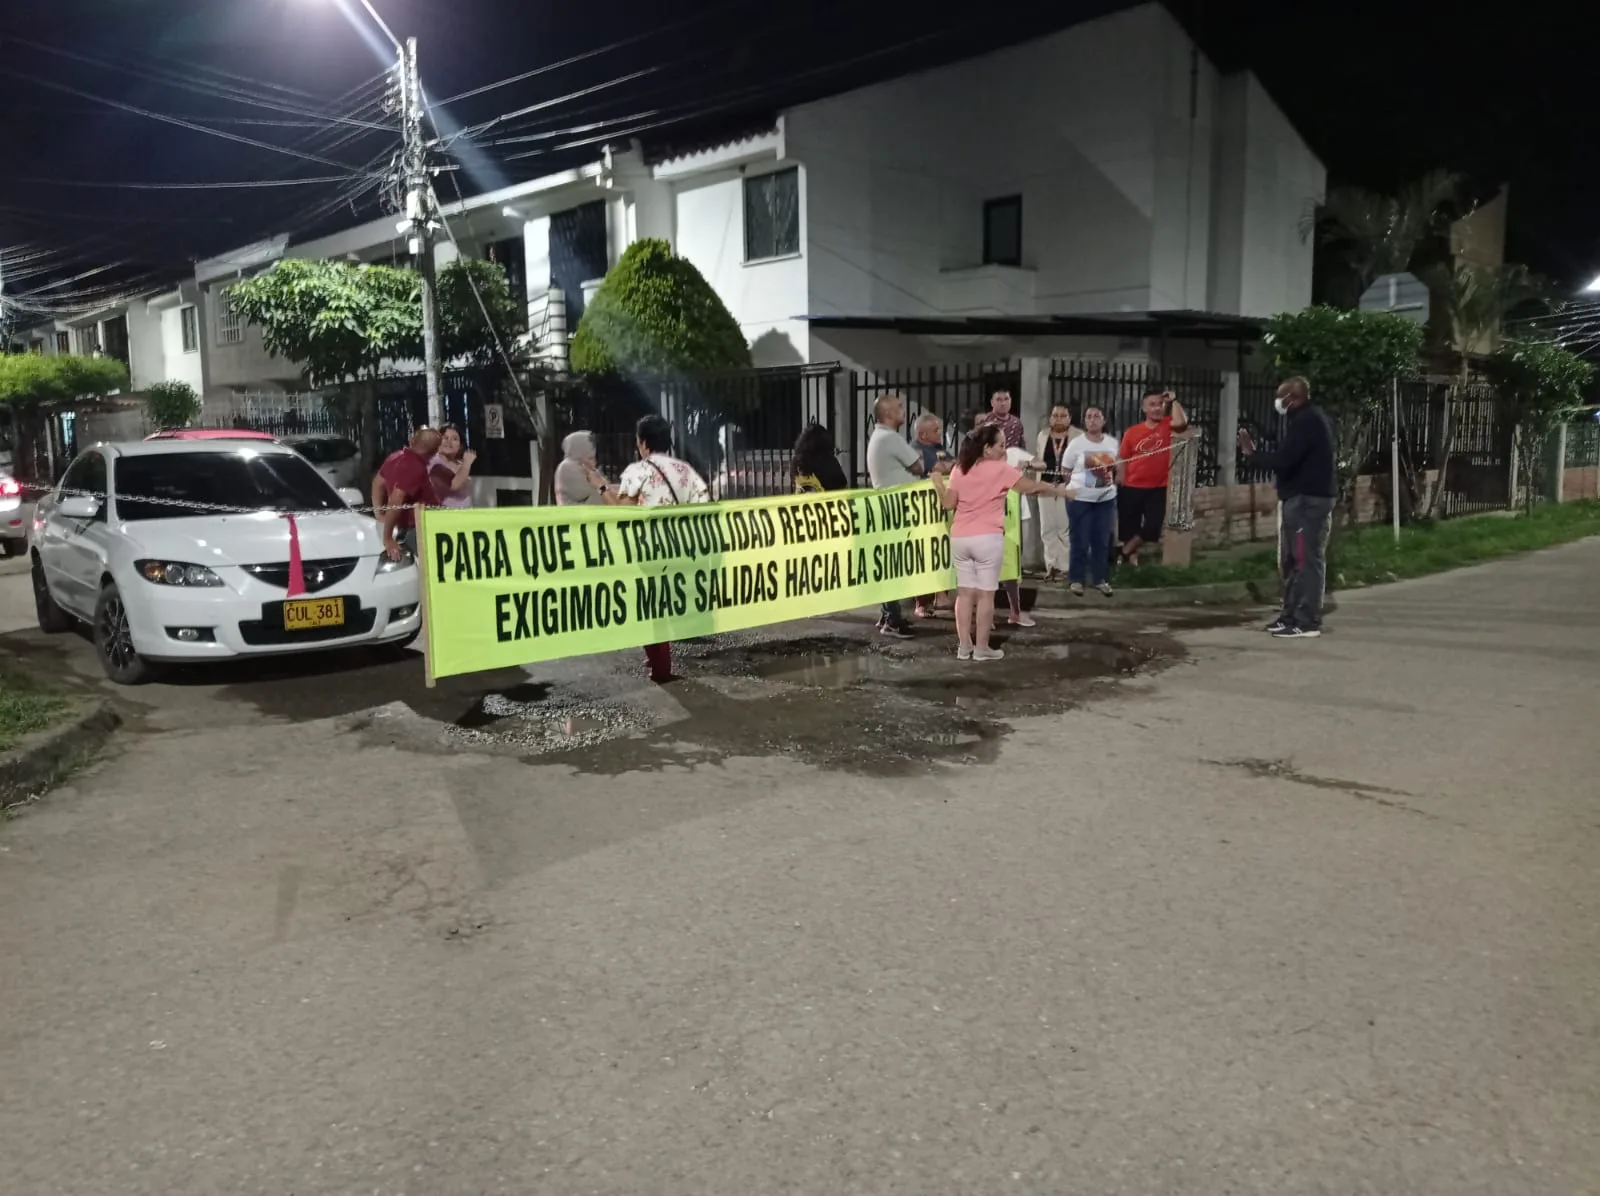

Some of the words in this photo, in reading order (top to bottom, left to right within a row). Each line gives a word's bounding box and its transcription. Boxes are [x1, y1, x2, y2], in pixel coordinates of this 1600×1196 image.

[435, 527, 513, 583] PARA
[519, 524, 575, 580] QUE
[582, 522, 615, 569] LA
[616, 508, 776, 564] TRANQUILIDAD
[777, 500, 860, 546] REGRESE
[864, 497, 876, 534] A
[287, 606, 312, 622] CUL
[316, 604, 341, 619] 381
[495, 580, 628, 643] EXIGIMOS
[635, 566, 687, 622] MÁS
[695, 560, 778, 613] SALIDAS
[785, 552, 842, 599] HACIA
[847, 547, 868, 587] LA
[873, 532, 925, 583] SIMÓN
[930, 535, 954, 573] BO
